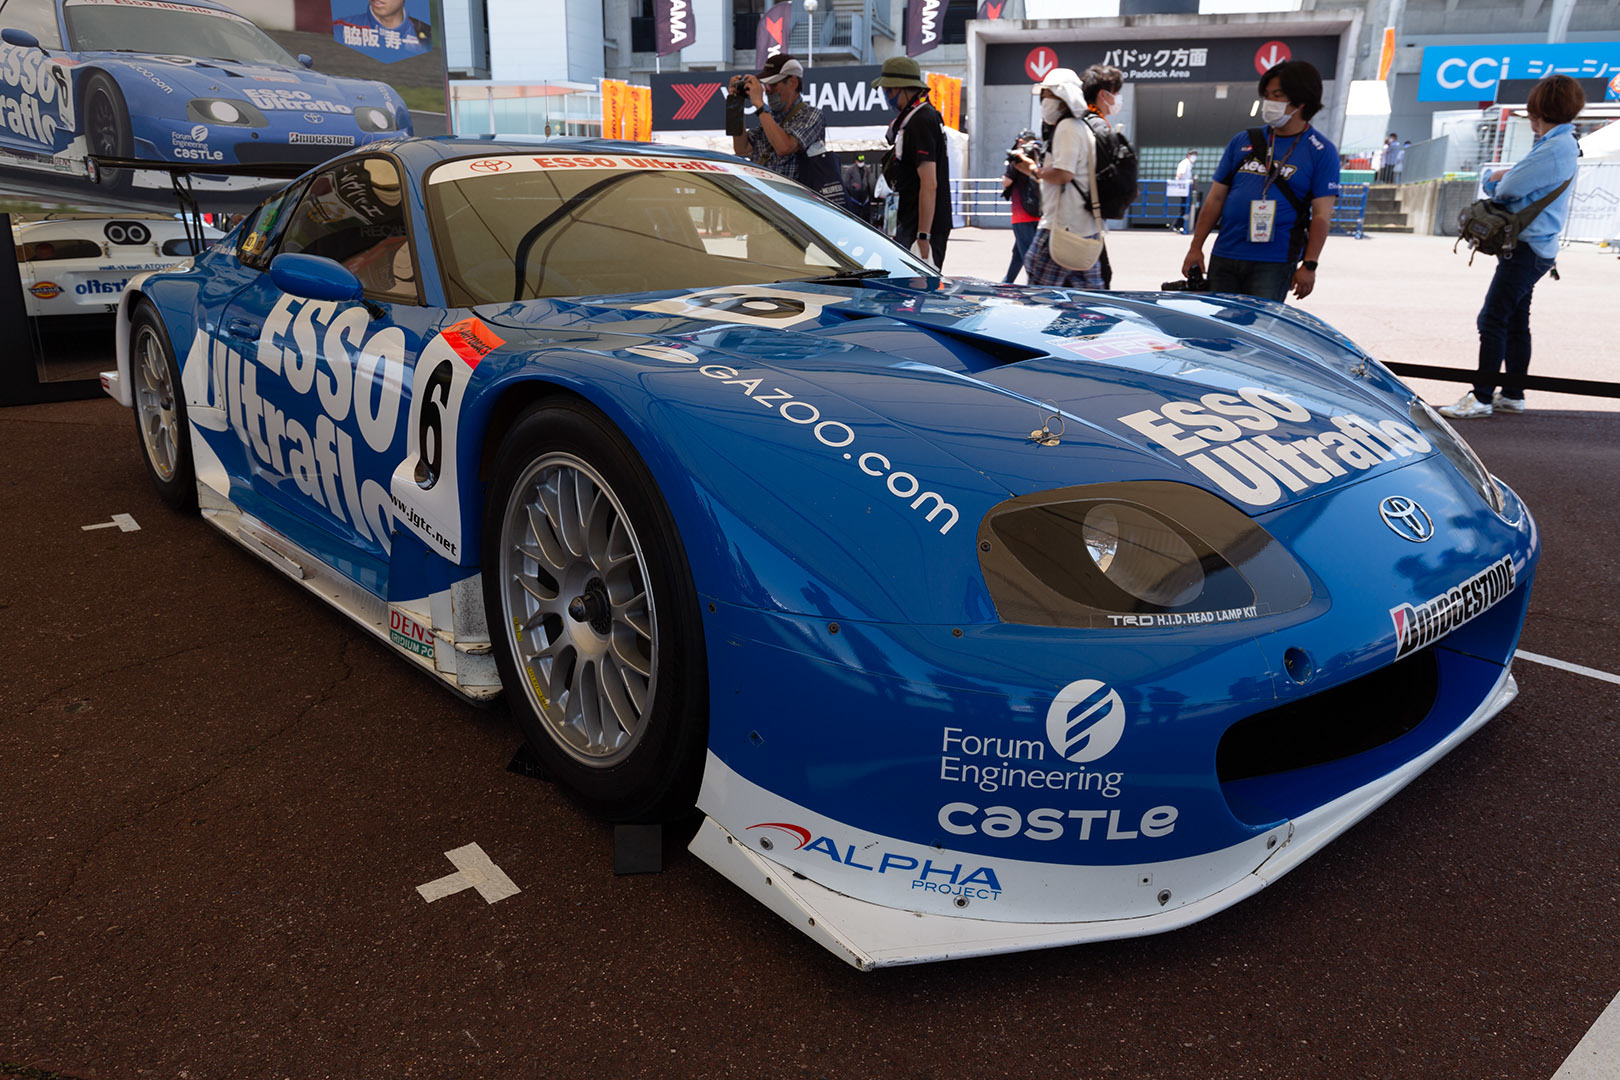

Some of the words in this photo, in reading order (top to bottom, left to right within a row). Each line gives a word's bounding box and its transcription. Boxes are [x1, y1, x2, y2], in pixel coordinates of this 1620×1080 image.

[344, 26, 380, 48] 脇阪
[1103, 48, 1208, 67] パドック方面
[1129, 70, 1168, 78] Paddock
[1169, 69, 1190, 77] Area
[242, 89, 312, 100] ESSO
[255, 97, 352, 114] Ultraflo
[172, 131, 192, 140] Forum
[172, 139, 208, 151] Engineering
[290, 133, 354, 145] BRIDGESTONE
[534, 157, 617, 169] ESSO
[622, 158, 729, 172] Ultraflo
[257, 292, 406, 453] ESSO
[414, 359, 453, 490] 6
[1117, 387, 1312, 456] ESSO
[181, 328, 394, 557] Ultraflo
[699, 364, 960, 535] GAZOO.com
[1185, 413, 1432, 506] Ultraflo
[1108, 615, 1153, 626] TRD
[1157, 613, 1186, 625] H.I.D.
[1187, 611, 1214, 623] HEAD
[1215, 608, 1242, 621] LAMP
[1243, 606, 1257, 618] KIT
[1394, 556, 1515, 660] BRIDGESTONE
[942, 727, 1045, 760] Forum
[940, 756, 1124, 798] Engineering
[803, 836, 1002, 890] ALPHA
[911, 879, 1003, 901] PROJECT
